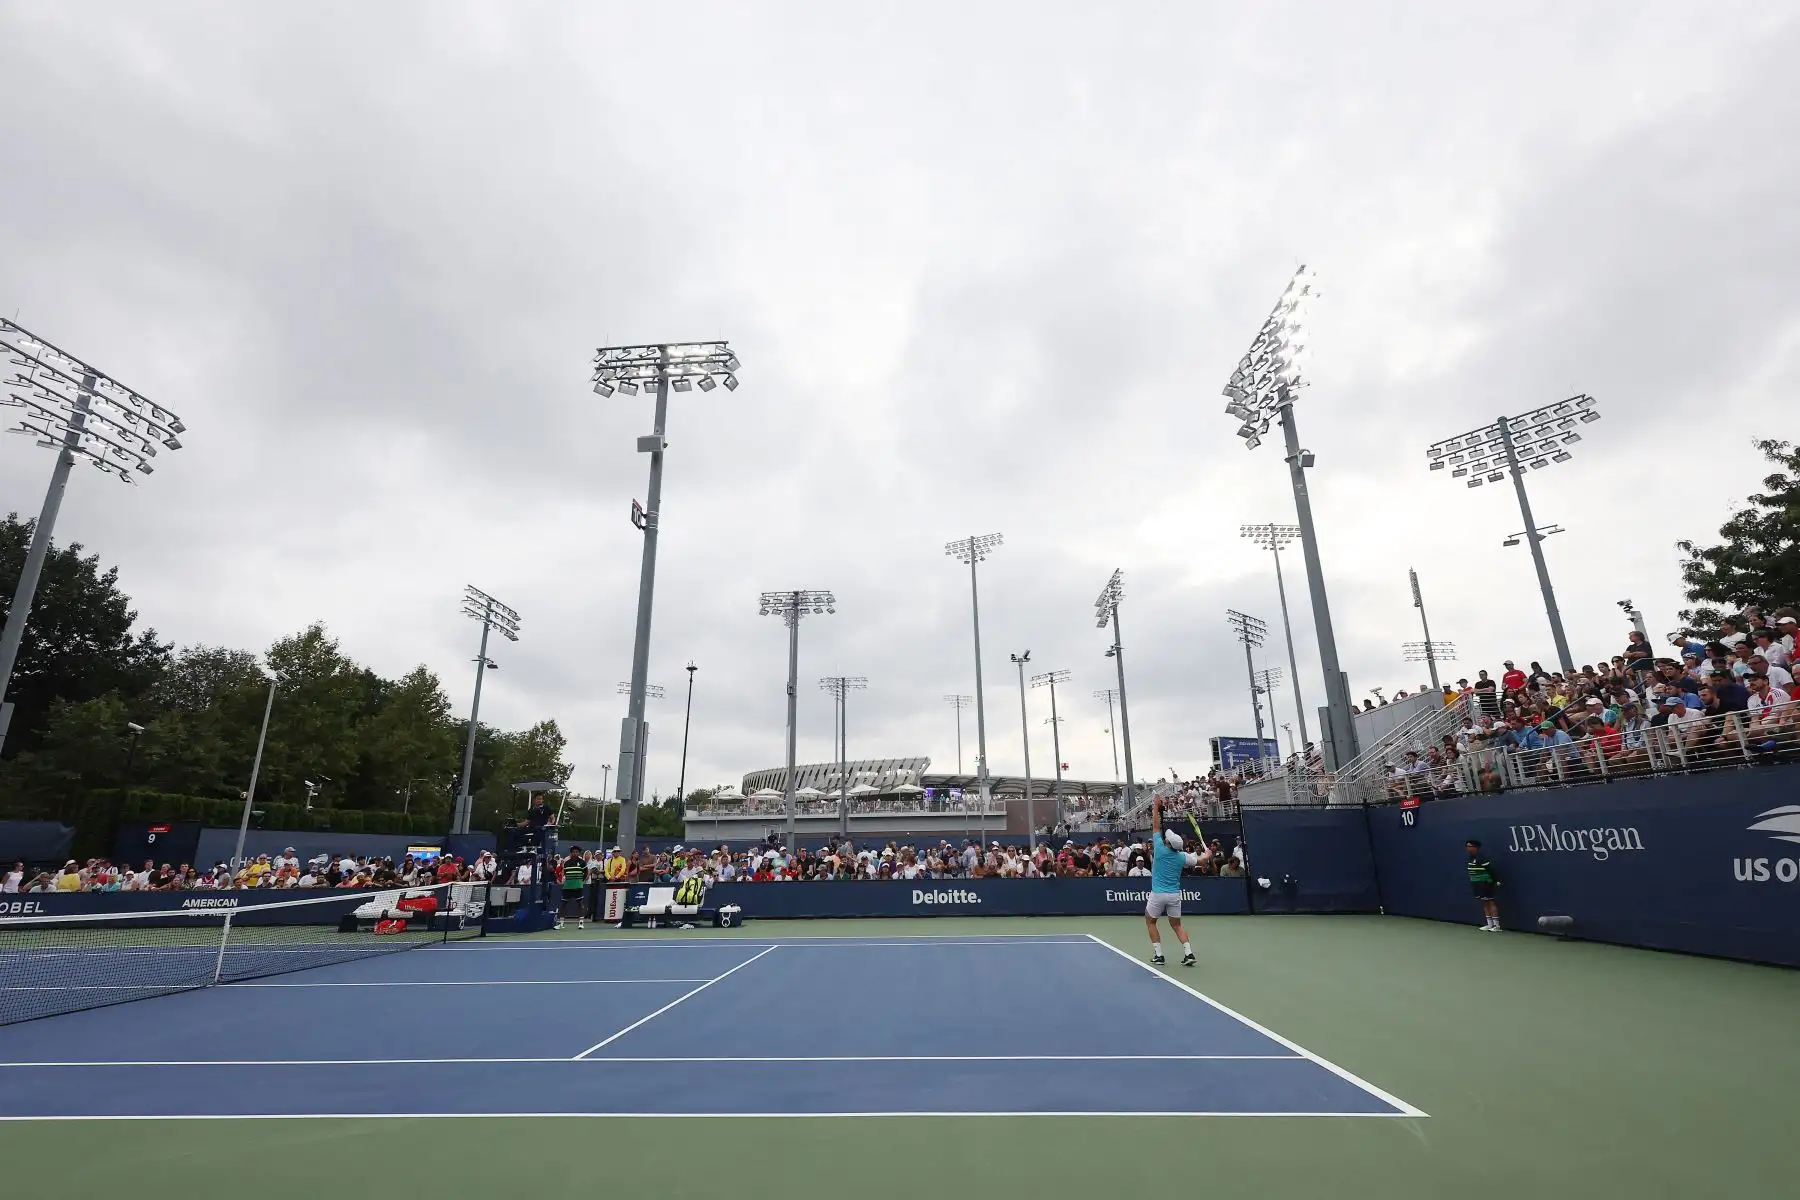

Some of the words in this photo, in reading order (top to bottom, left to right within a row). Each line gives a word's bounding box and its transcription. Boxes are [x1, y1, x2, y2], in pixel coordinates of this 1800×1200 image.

[1402, 811, 1414, 826] 10
[148, 833, 156, 843] 9
[1509, 823, 1645, 861] J.P.Morgan
[912, 889, 982, 905] Deloitte.
[1105, 889, 1151, 902] Emirate
[0, 901, 44, 914] OBEL
[182, 898, 239, 908] AMERICAN
[610, 890, 618, 918] Wilson
